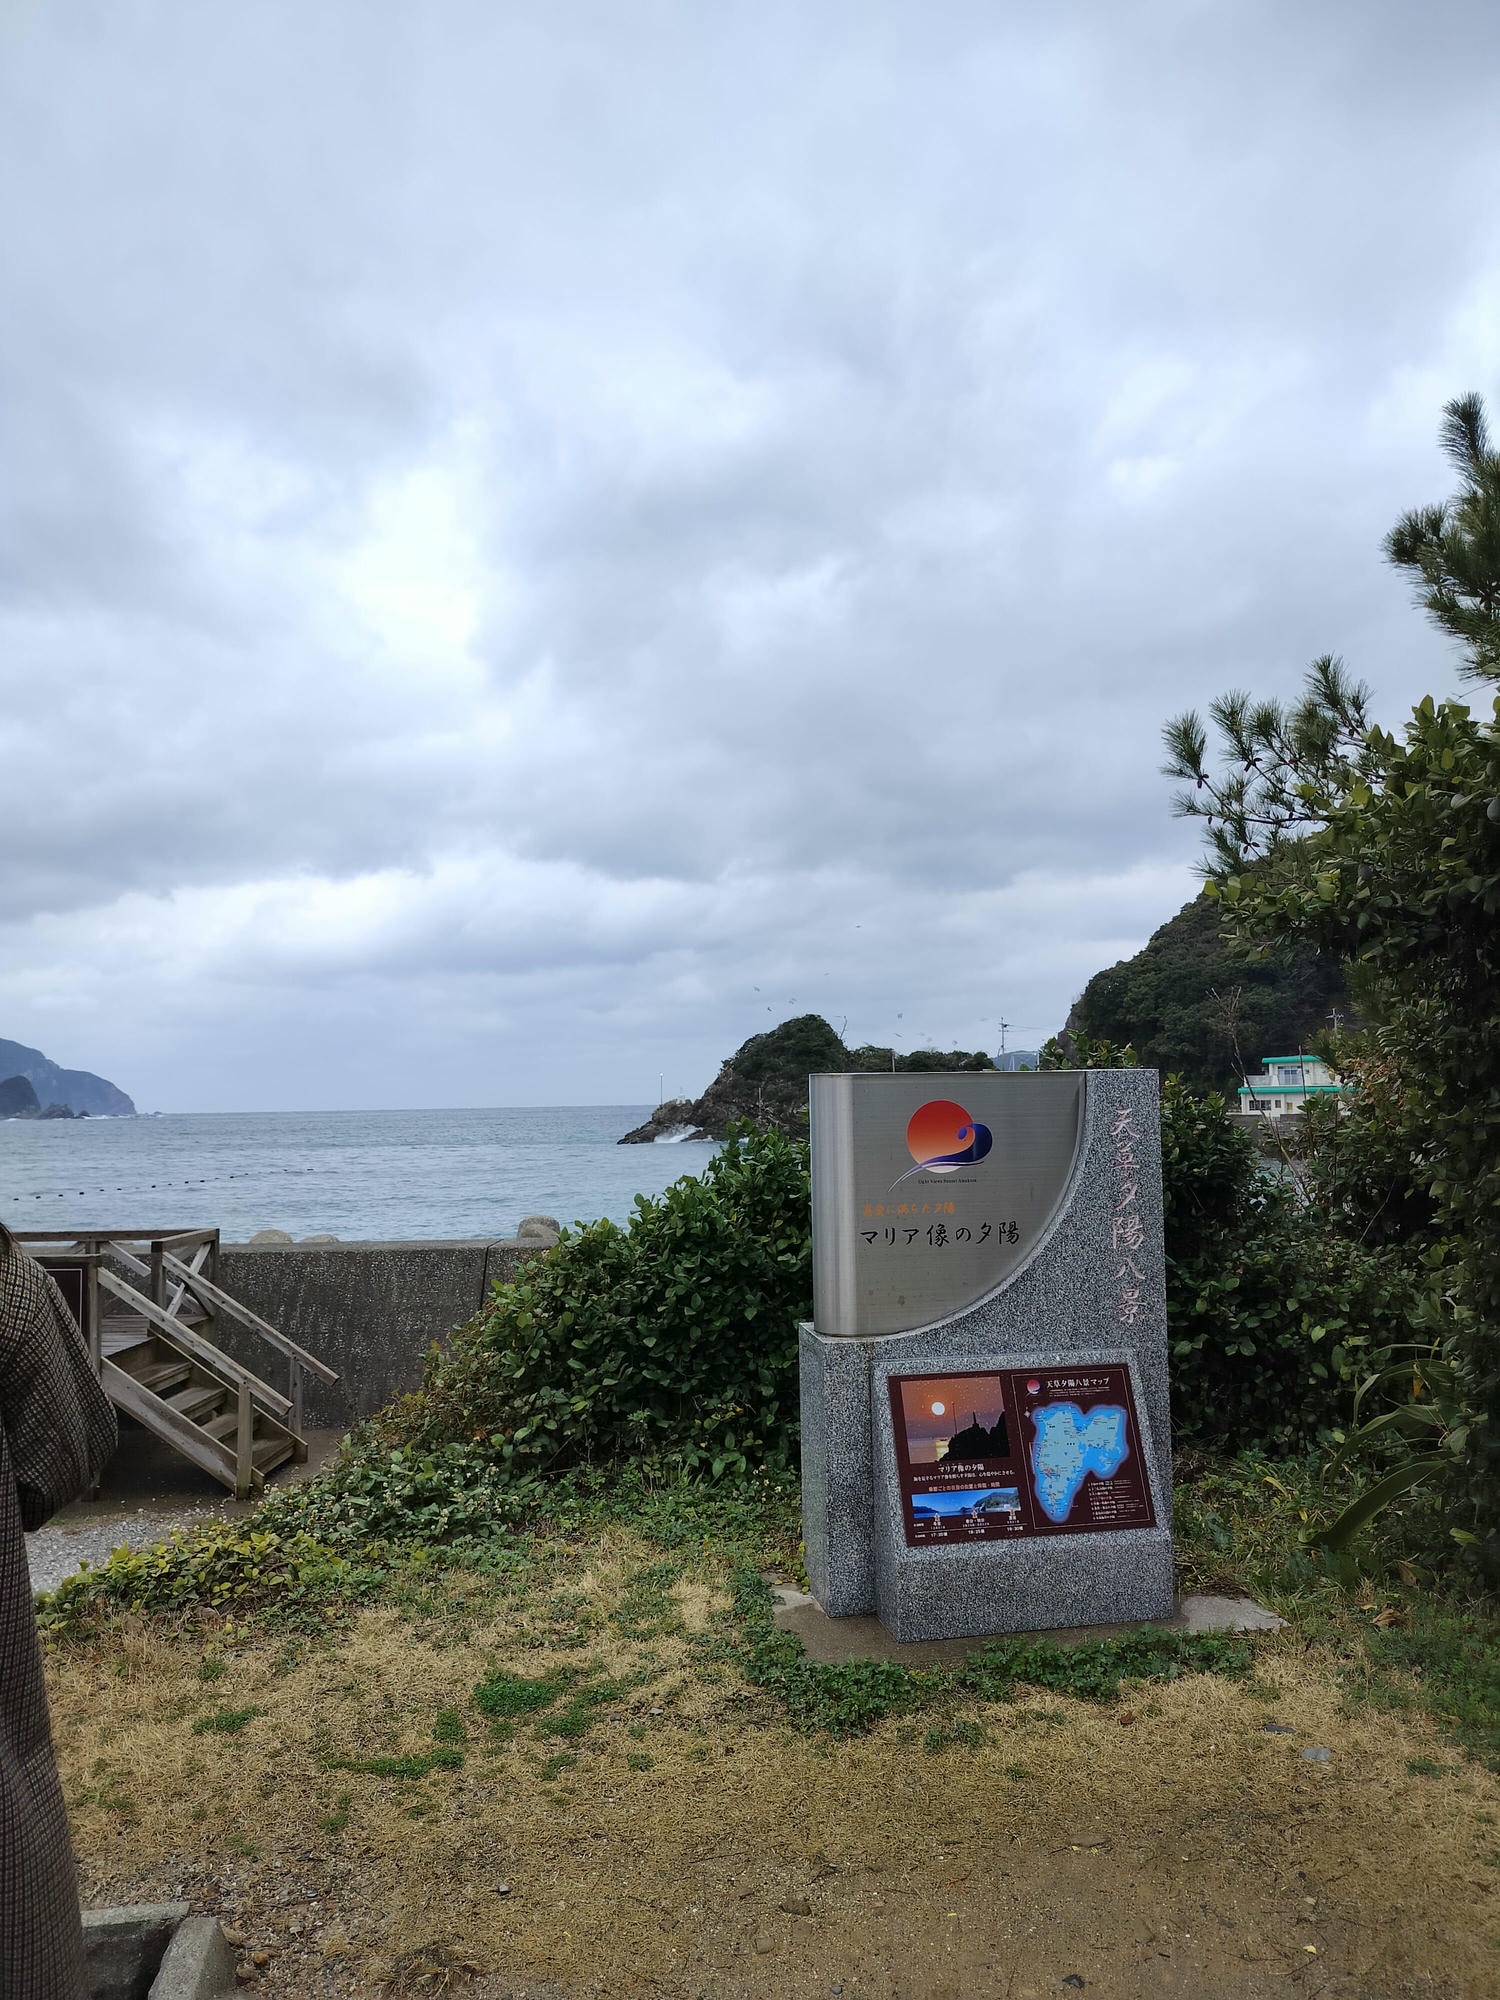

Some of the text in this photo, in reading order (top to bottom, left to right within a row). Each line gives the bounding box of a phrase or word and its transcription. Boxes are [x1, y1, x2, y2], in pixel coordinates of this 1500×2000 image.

[860, 1220, 1020, 1248] マリア像の夕陽
